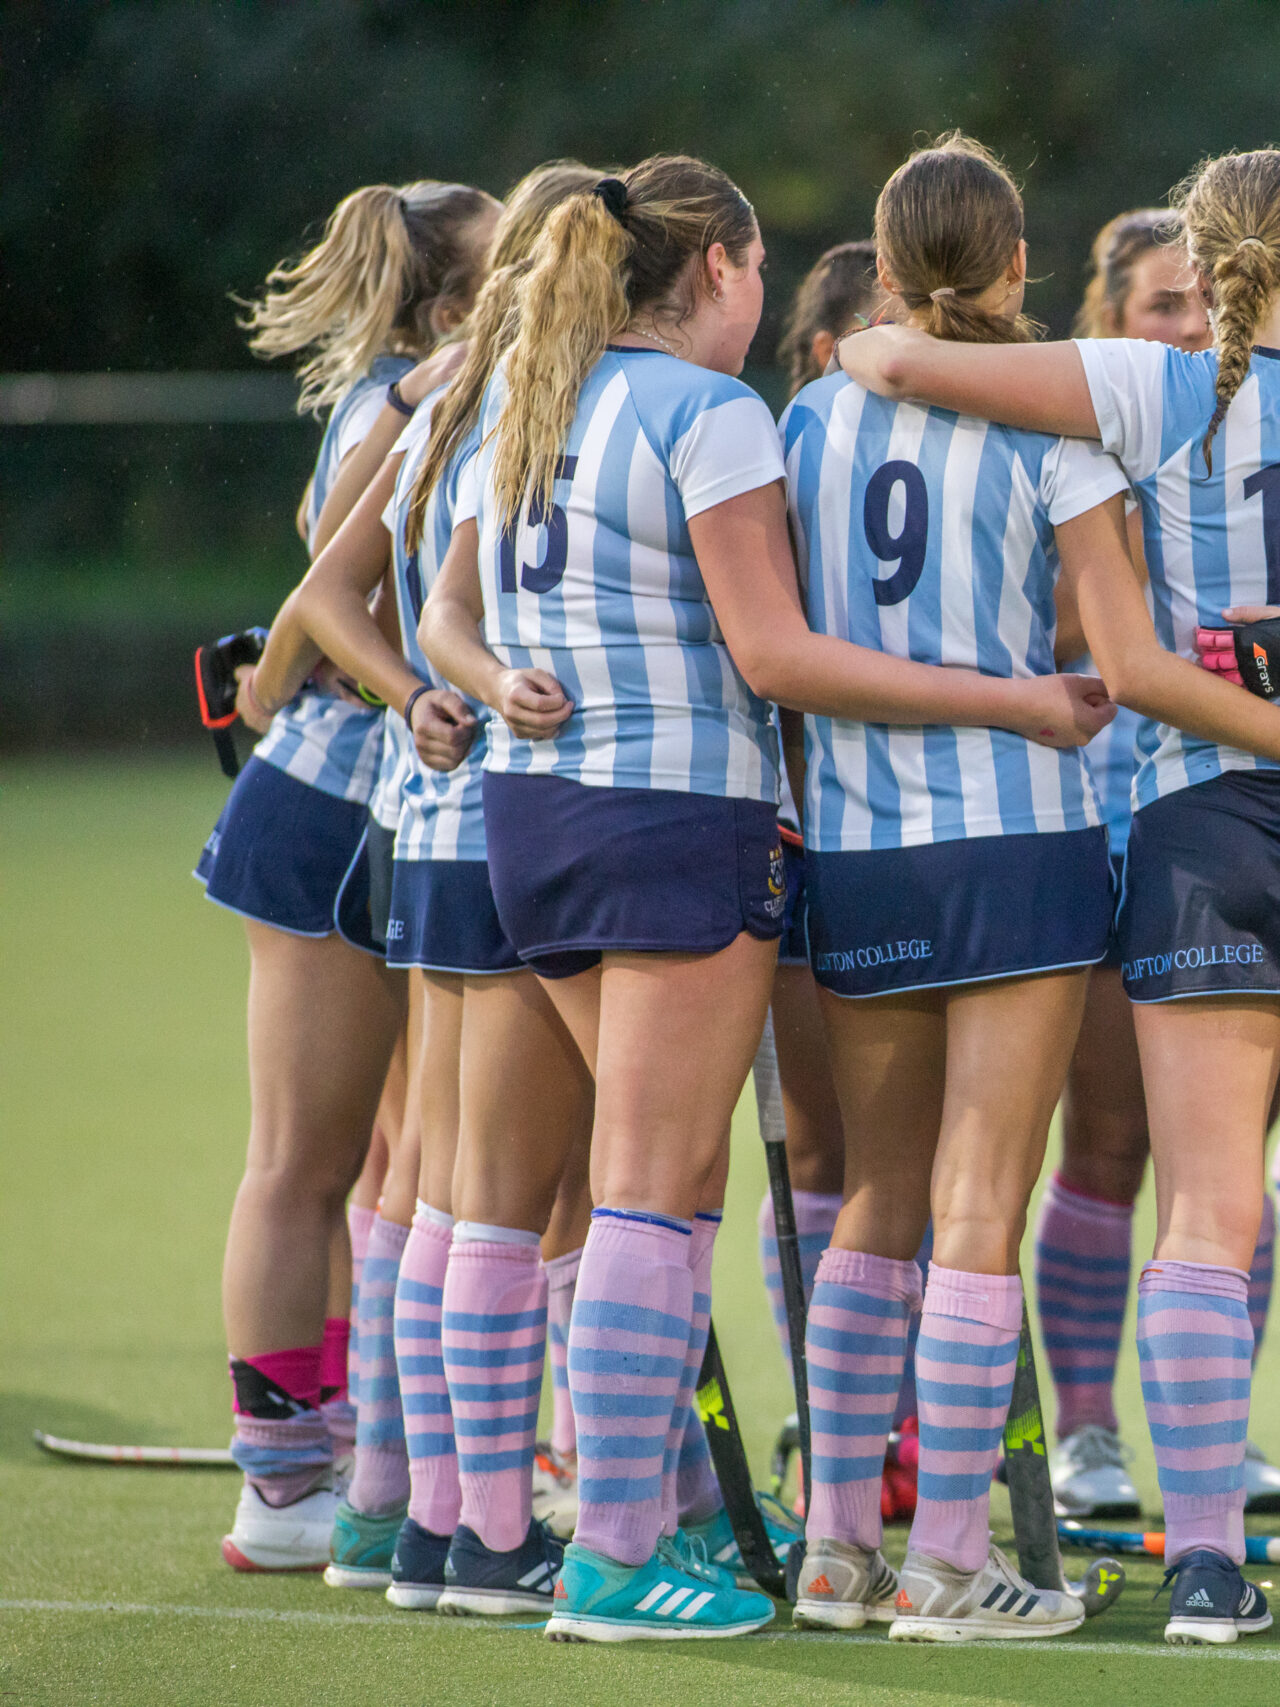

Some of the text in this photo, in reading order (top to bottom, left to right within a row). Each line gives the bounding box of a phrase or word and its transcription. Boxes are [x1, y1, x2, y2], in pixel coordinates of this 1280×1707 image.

[863, 459, 929, 607] 9
[1255, 655, 1274, 694] Grays
[856, 938, 933, 968] COLLEGE
[1174, 943, 1264, 969] COLLEGE
[1185, 1599, 1214, 1608] adidas
